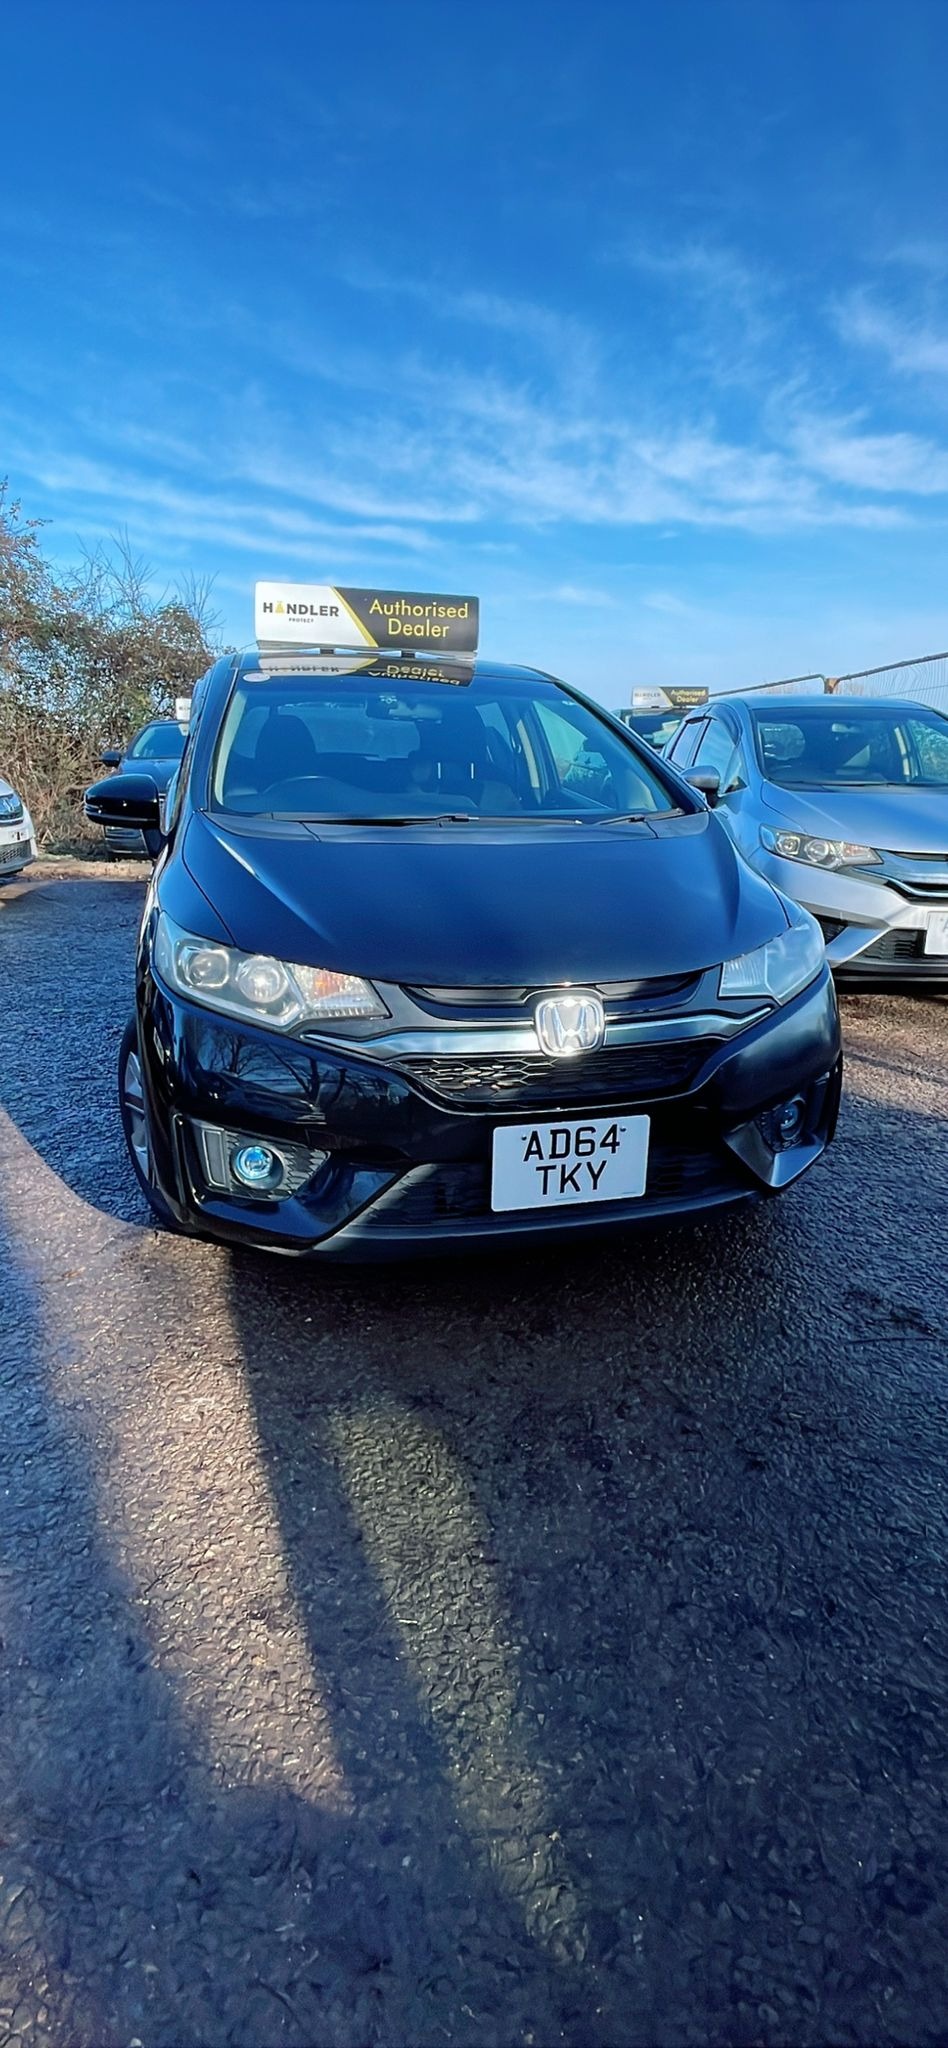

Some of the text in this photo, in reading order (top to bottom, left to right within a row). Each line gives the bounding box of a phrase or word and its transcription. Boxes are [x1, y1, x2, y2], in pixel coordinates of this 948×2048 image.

[369, 599, 469, 619] Authorised
[388, 618, 450, 638] Dealer
[523, 1124, 620, 1162] AD64
[536, 1160, 607, 1195] TKY
